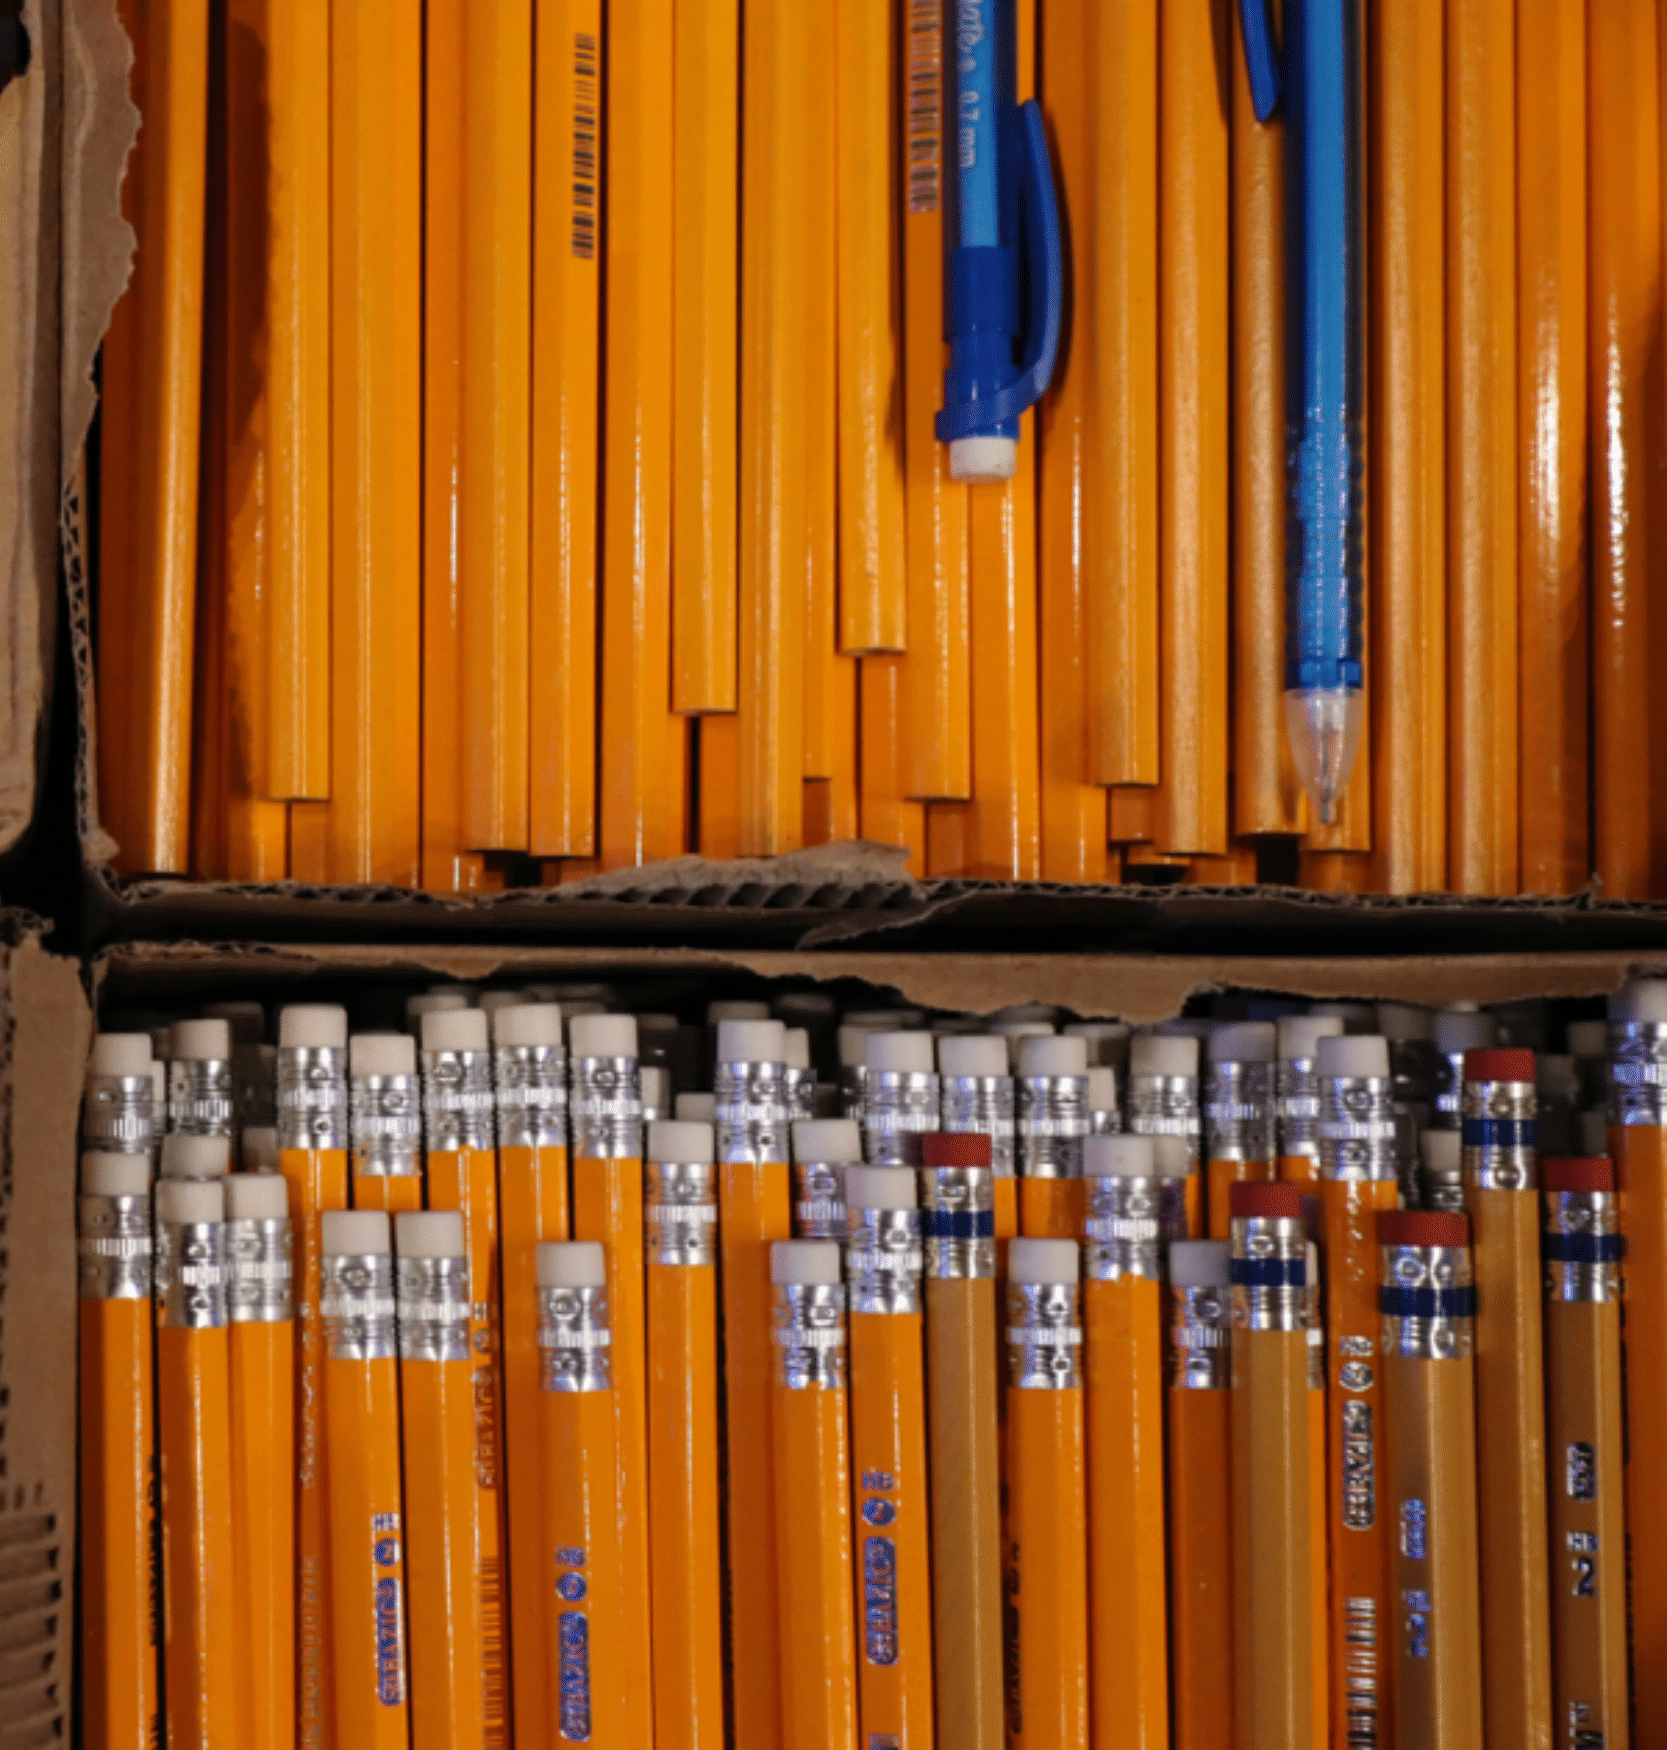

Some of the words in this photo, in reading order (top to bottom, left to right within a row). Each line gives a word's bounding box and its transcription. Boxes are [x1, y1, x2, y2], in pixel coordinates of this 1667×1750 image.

[960, 127, 976, 167] mm
[1572, 1557, 1594, 1597] 2
[1405, 1613, 1429, 1658] 2
